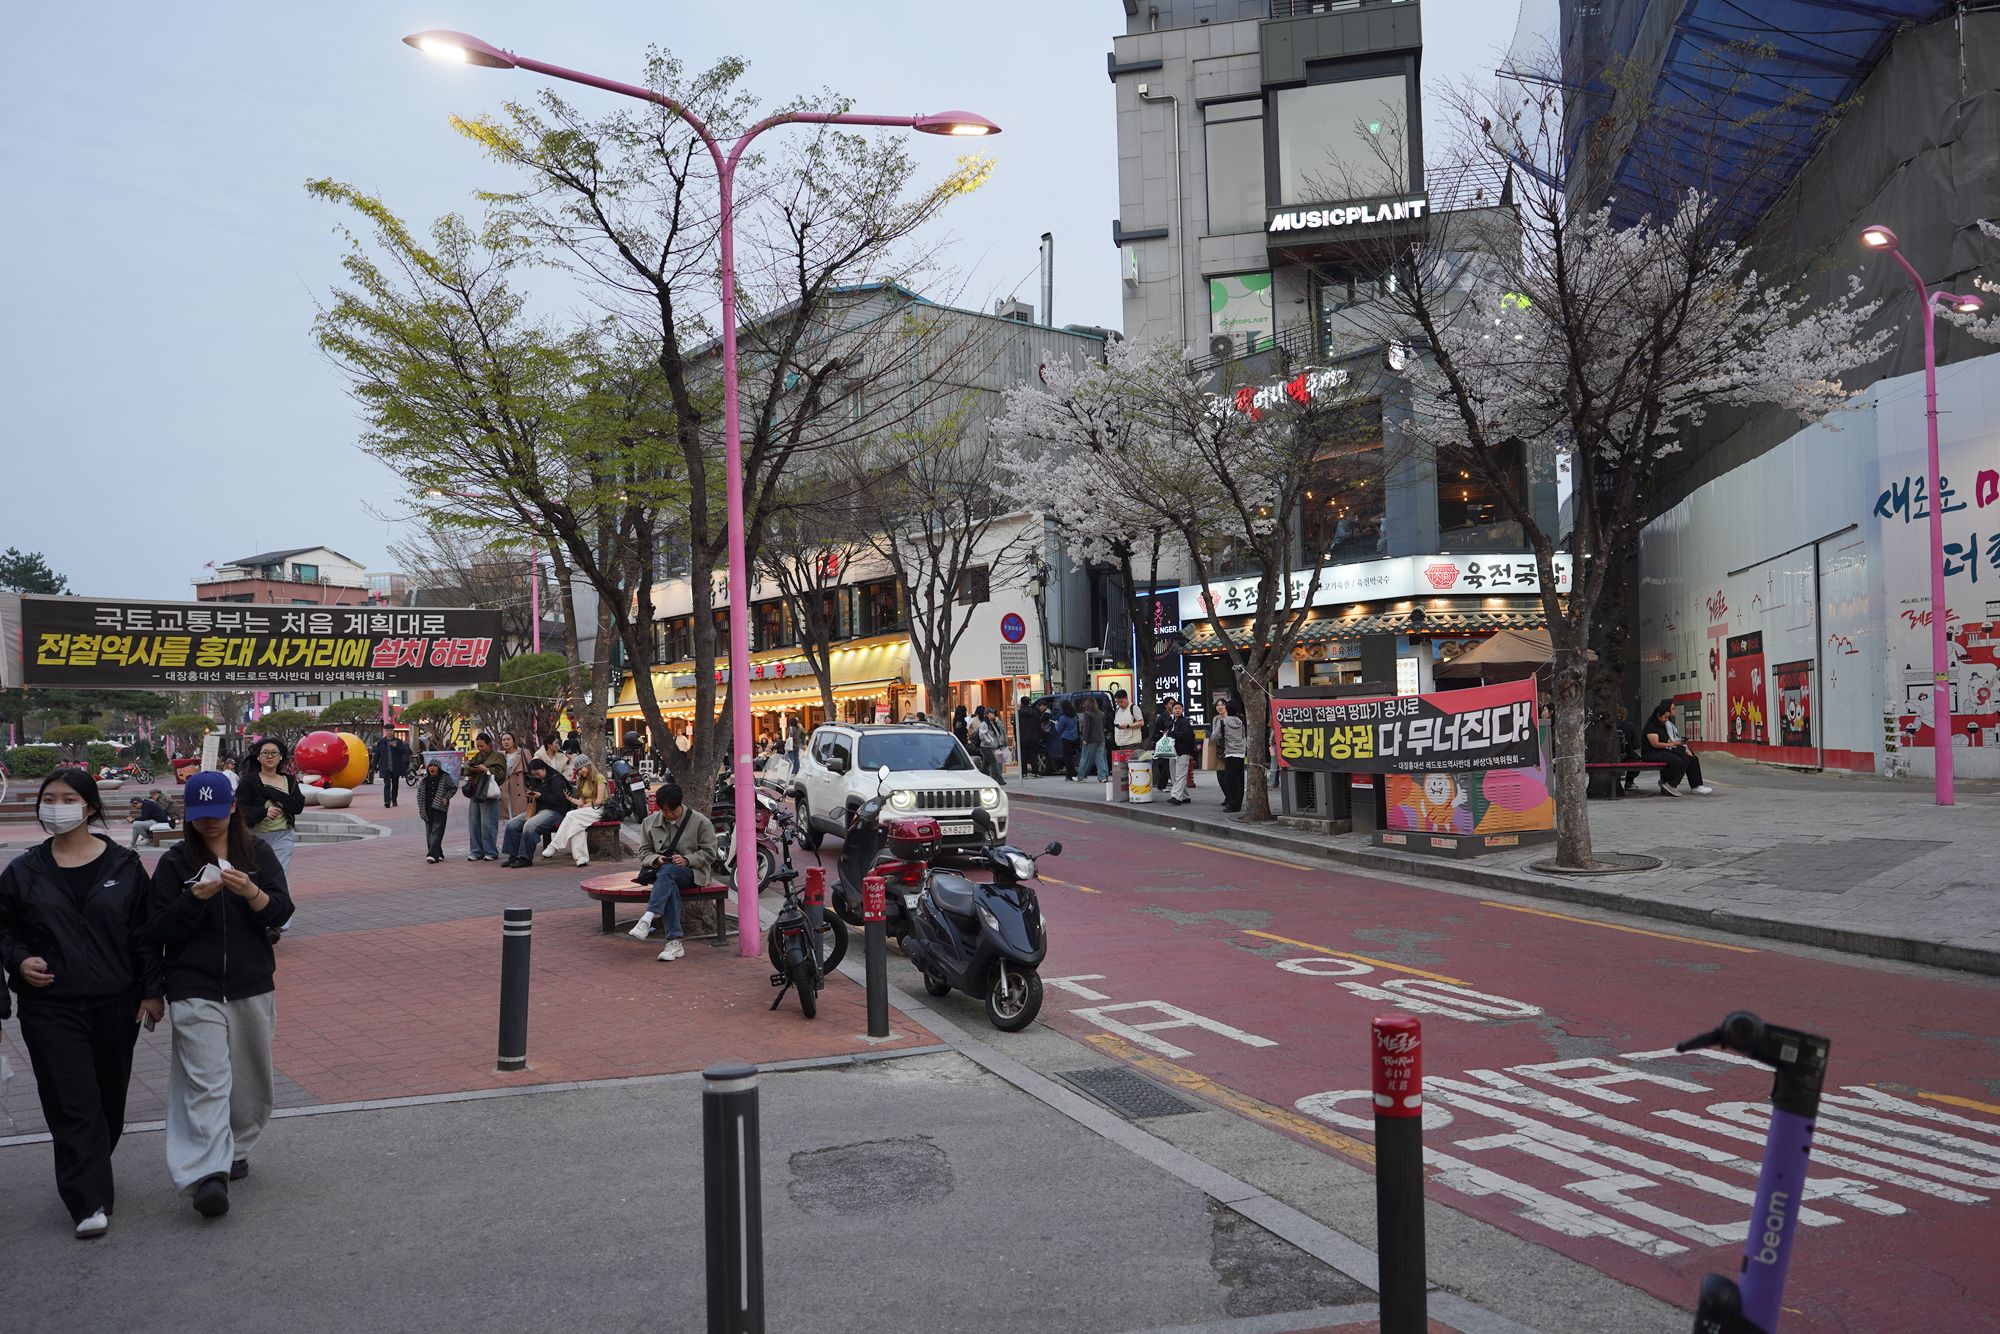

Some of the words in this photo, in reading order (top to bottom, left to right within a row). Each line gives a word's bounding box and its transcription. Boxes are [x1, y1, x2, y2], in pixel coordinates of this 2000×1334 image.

[1269, 200, 1426, 232] MUSICPLANT
[1873, 476, 1967, 524] 새로운
[1943, 533, 1978, 583] 더
[94, 607, 270, 634] 국토교통부는
[280, 612, 334, 635] 처음
[343, 613, 446, 635] 계획대로
[1153, 625, 1177, 635] SINGER
[1900, 608, 1960, 630] 레드드
[37, 633, 192, 667] 전철역사를
[195, 636, 257, 667] 홍대
[257, 637, 372, 668] 사거리에
[371, 637, 427, 668] 설치
[430, 637, 493, 668] 하라!
[165, 671, 220, 682] 대장홍대선
[225, 671, 310, 682] 레드로드역사반대
[314, 671, 385, 681] 비상대책위원회
[1276, 706, 1313, 722] 6년간의
[1314, 705, 1347, 722] 전철역
[1348, 701, 1381, 720] 땅파기
[1384, 697, 1419, 718] 공사로
[1280, 726, 1325, 759] 홍대
[1329, 724, 1374, 759] 상권
[1378, 721, 1403, 757] 다
[1406, 701, 1531, 756] 무너진다!
[199, 786, 213, 801] NY
[1753, 1191, 1789, 1265] beam
